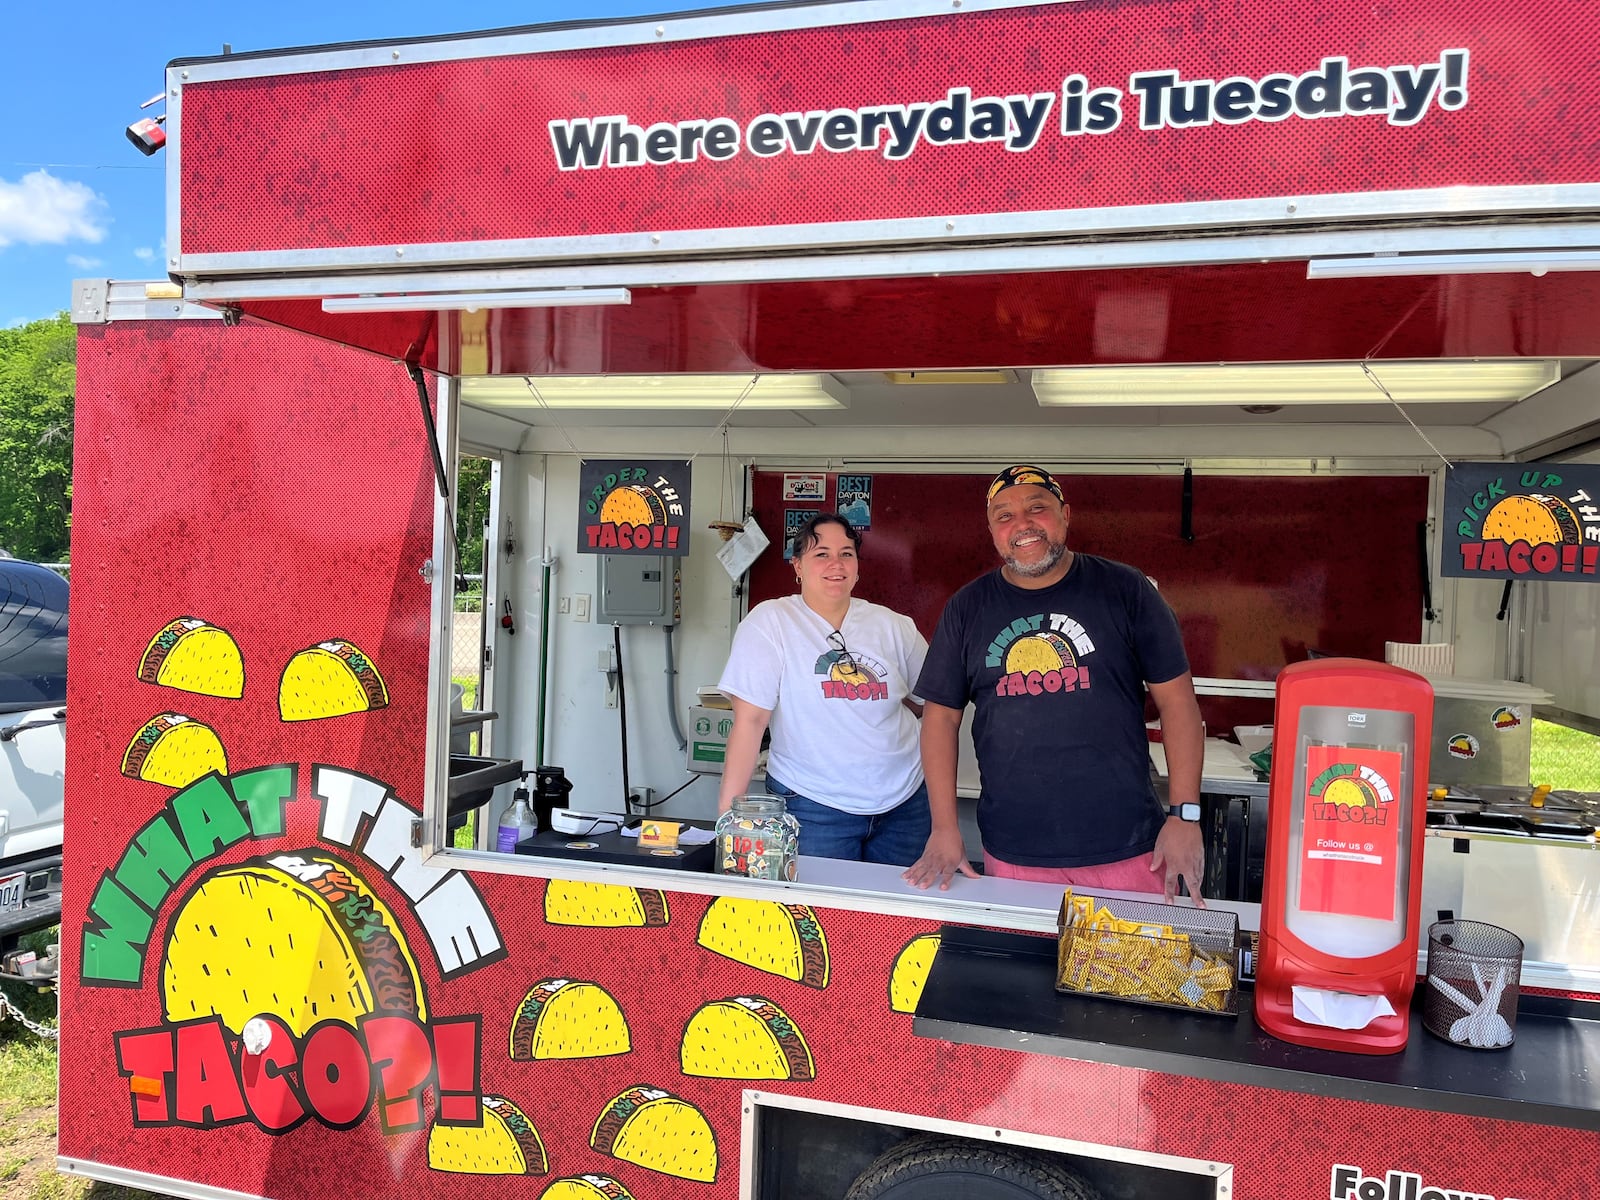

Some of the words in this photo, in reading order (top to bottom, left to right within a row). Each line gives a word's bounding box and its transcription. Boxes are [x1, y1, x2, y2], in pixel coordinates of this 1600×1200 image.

[549, 115, 741, 171] Where
[747, 87, 1056, 160] everyday
[1062, 73, 1123, 135] is
[1130, 48, 1470, 132] Tuesday!
[585, 467, 648, 515] ORDER
[654, 475, 684, 516] THE
[838, 476, 871, 492] BEST
[838, 491, 870, 499] DAYTON
[1457, 477, 1506, 538] PICK
[1519, 471, 1563, 489] UP
[1568, 488, 1600, 543] THE
[585, 522, 681, 550] TACO!!
[1460, 541, 1600, 574] TACO!!
[985, 613, 1045, 668] WHAT
[1049, 613, 1096, 657] THE
[821, 680, 889, 701] TACO?!
[995, 665, 1091, 697] TACO?!
[1308, 763, 1358, 797] WHAT
[1359, 764, 1395, 804] THE
[1312, 802, 1388, 826] TACO?!
[1316, 838, 1347, 849] Follow
[1348, 842, 1361, 851] us
[81, 763, 298, 988] WHAT
[312, 763, 508, 982] THE
[0, 884, 19, 906] 04
[113, 1013, 483, 1136] TACO?!
